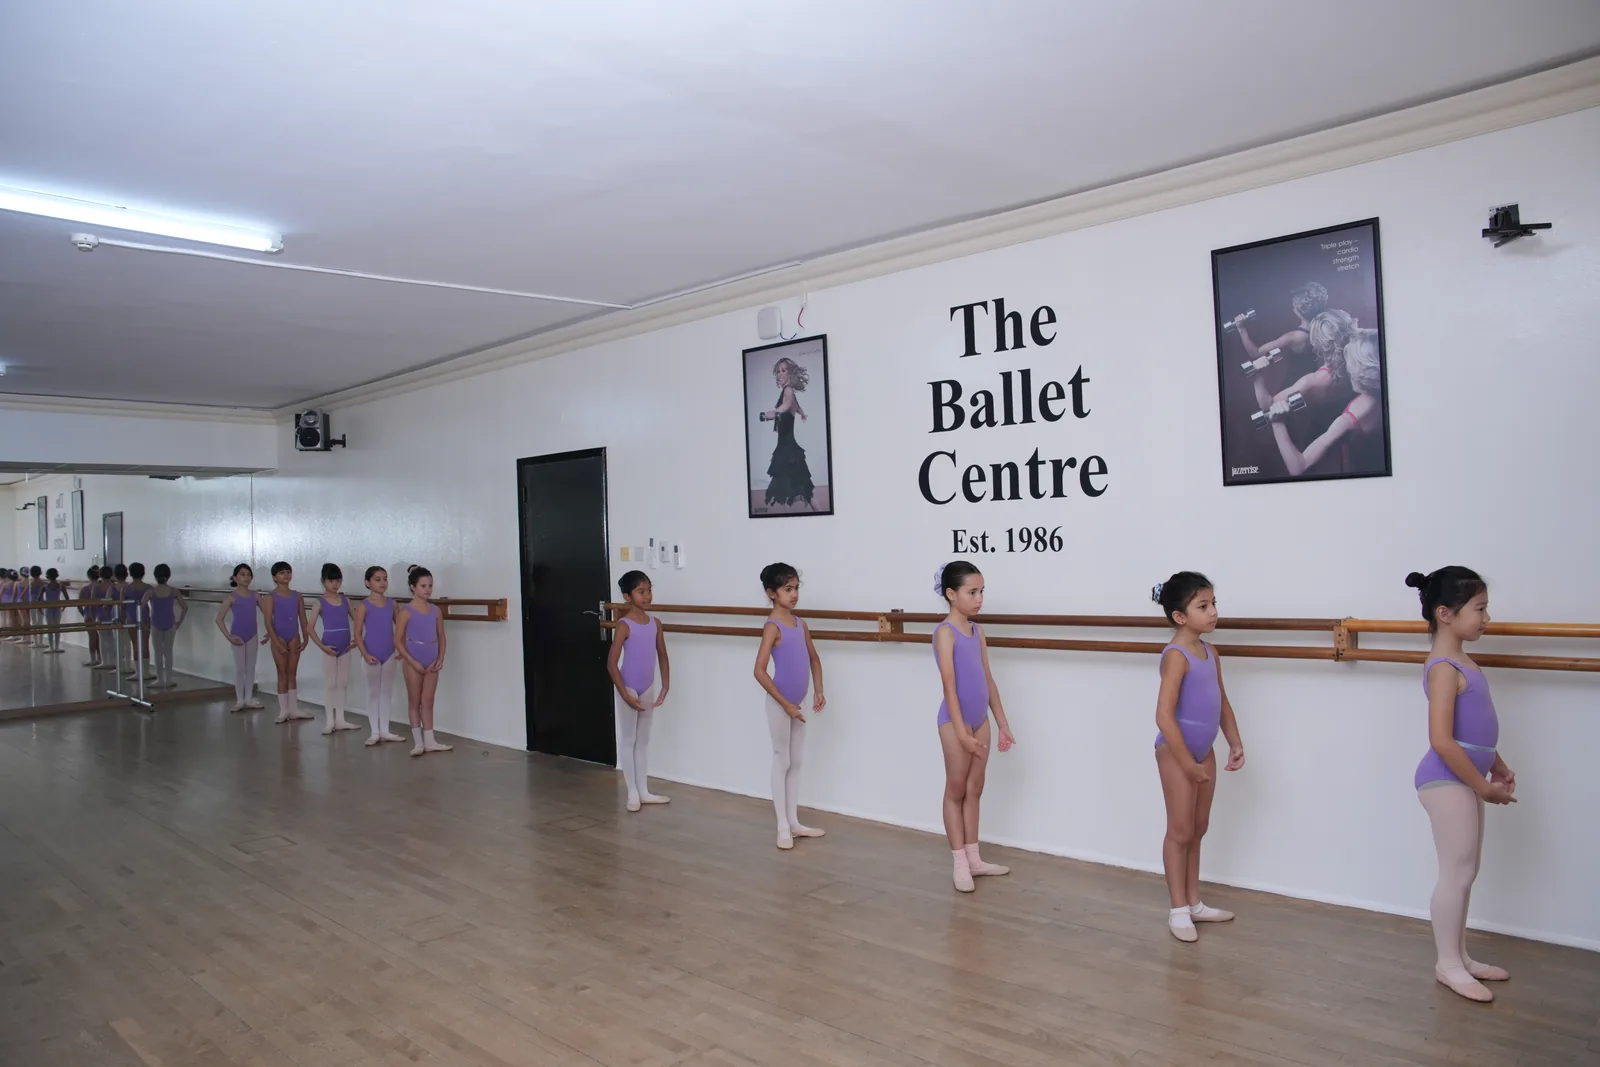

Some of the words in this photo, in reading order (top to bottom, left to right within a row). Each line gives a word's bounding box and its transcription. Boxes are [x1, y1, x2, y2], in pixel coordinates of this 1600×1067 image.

[1320, 242, 1337, 250] Triple
[1337, 247, 1359, 255] cardio
[1333, 255, 1360, 264] strength
[1337, 263, 1360, 272] stretch
[950, 297, 1057, 358] The
[927, 364, 1091, 433] Ballet
[918, 447, 1108, 505] Centre
[951, 529, 996, 553] Est.
[1005, 526, 1063, 553] 1986
